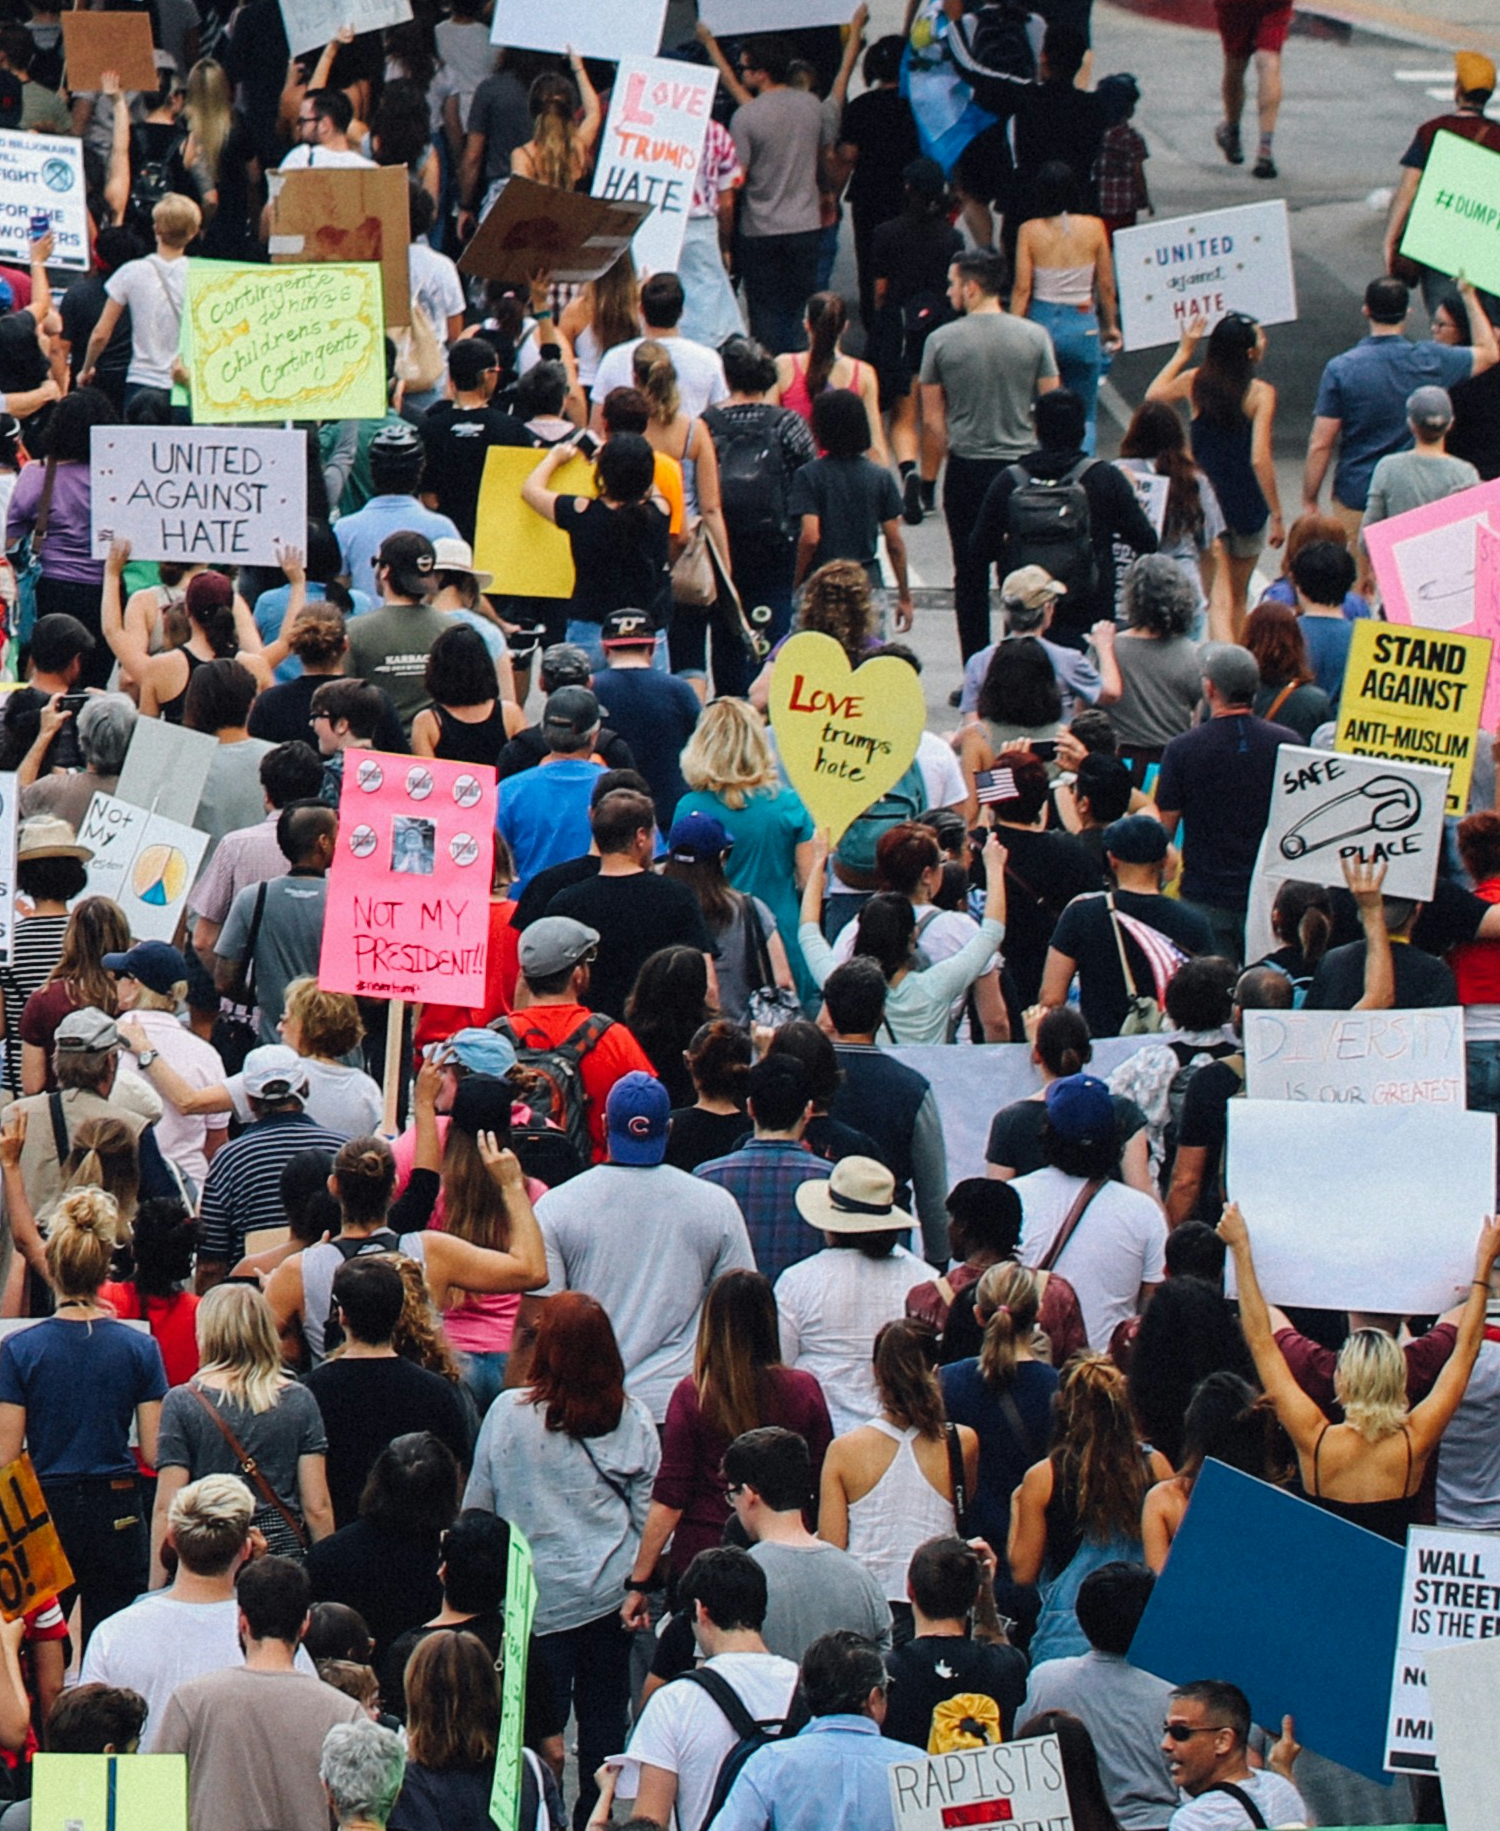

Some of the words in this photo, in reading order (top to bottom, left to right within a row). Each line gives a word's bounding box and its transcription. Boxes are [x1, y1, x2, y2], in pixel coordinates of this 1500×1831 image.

[621, 72, 704, 125] LOVE
[614, 127, 696, 170] TRUMPS
[604, 166, 682, 214] HATE
[1156, 236, 1234, 267] UNITED
[1165, 268, 1225, 291] against
[1173, 296, 1225, 320] HATE
[152, 442, 261, 475] UNITED
[126, 478, 269, 508] AGAINST
[160, 518, 248, 552] HATE
[1372, 634, 1467, 675] STAND
[788, 676, 864, 718] LOVE
[1361, 672, 1468, 713] AGAINST
[821, 720, 892, 757] trumps
[814, 748, 866, 782] hate
[1281, 758, 1345, 796] SAFE
[1339, 834, 1422, 862] PLACE
[354, 897, 408, 934] NOT
[420, 899, 469, 936] MY
[354, 934, 485, 977] PRESIDENT!!
[894, 1744, 1063, 1812] RAPISTS
